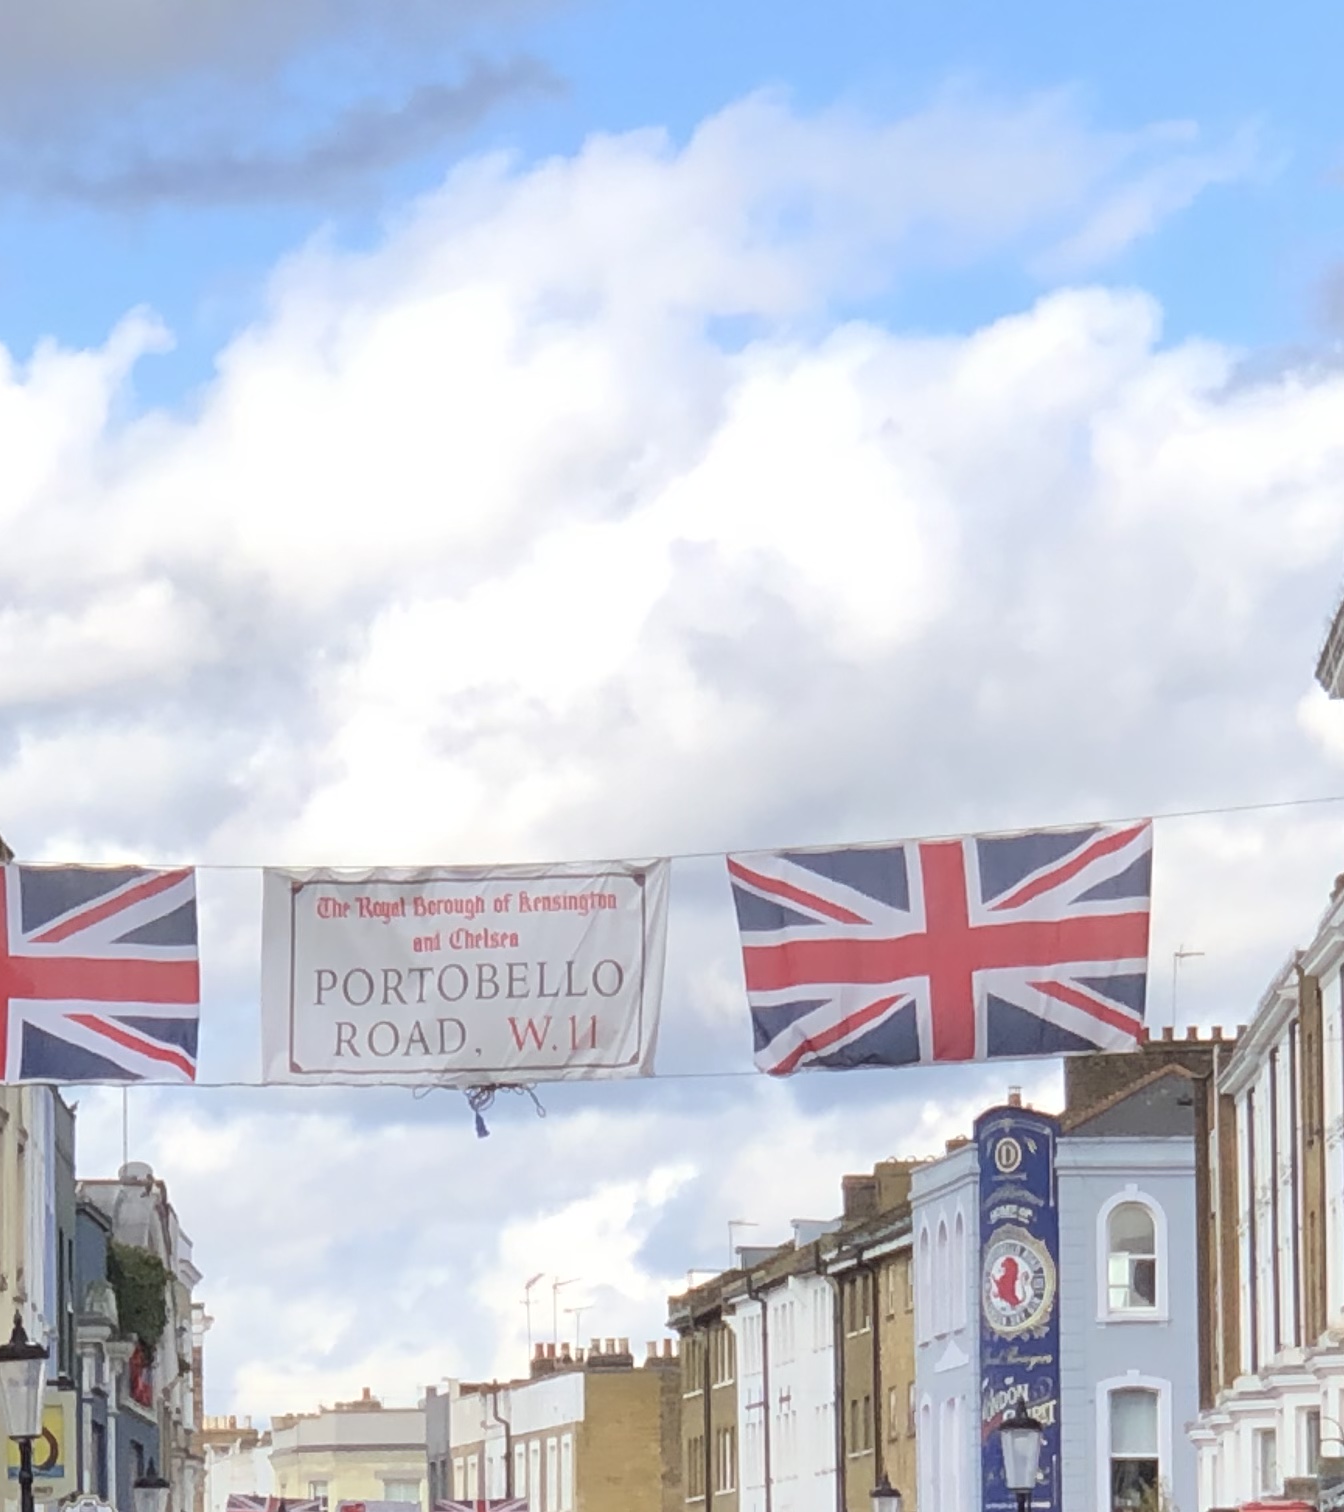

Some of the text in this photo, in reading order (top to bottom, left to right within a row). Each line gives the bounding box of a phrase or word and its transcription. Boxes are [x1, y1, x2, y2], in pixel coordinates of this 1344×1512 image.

[317, 890, 617, 925] The Royal Borough of Kensington
[413, 928, 519, 952] and Chelsea
[314, 959, 624, 1006] PORTOBELLO
[335, 1014, 598, 1058] ROAD, W.11
